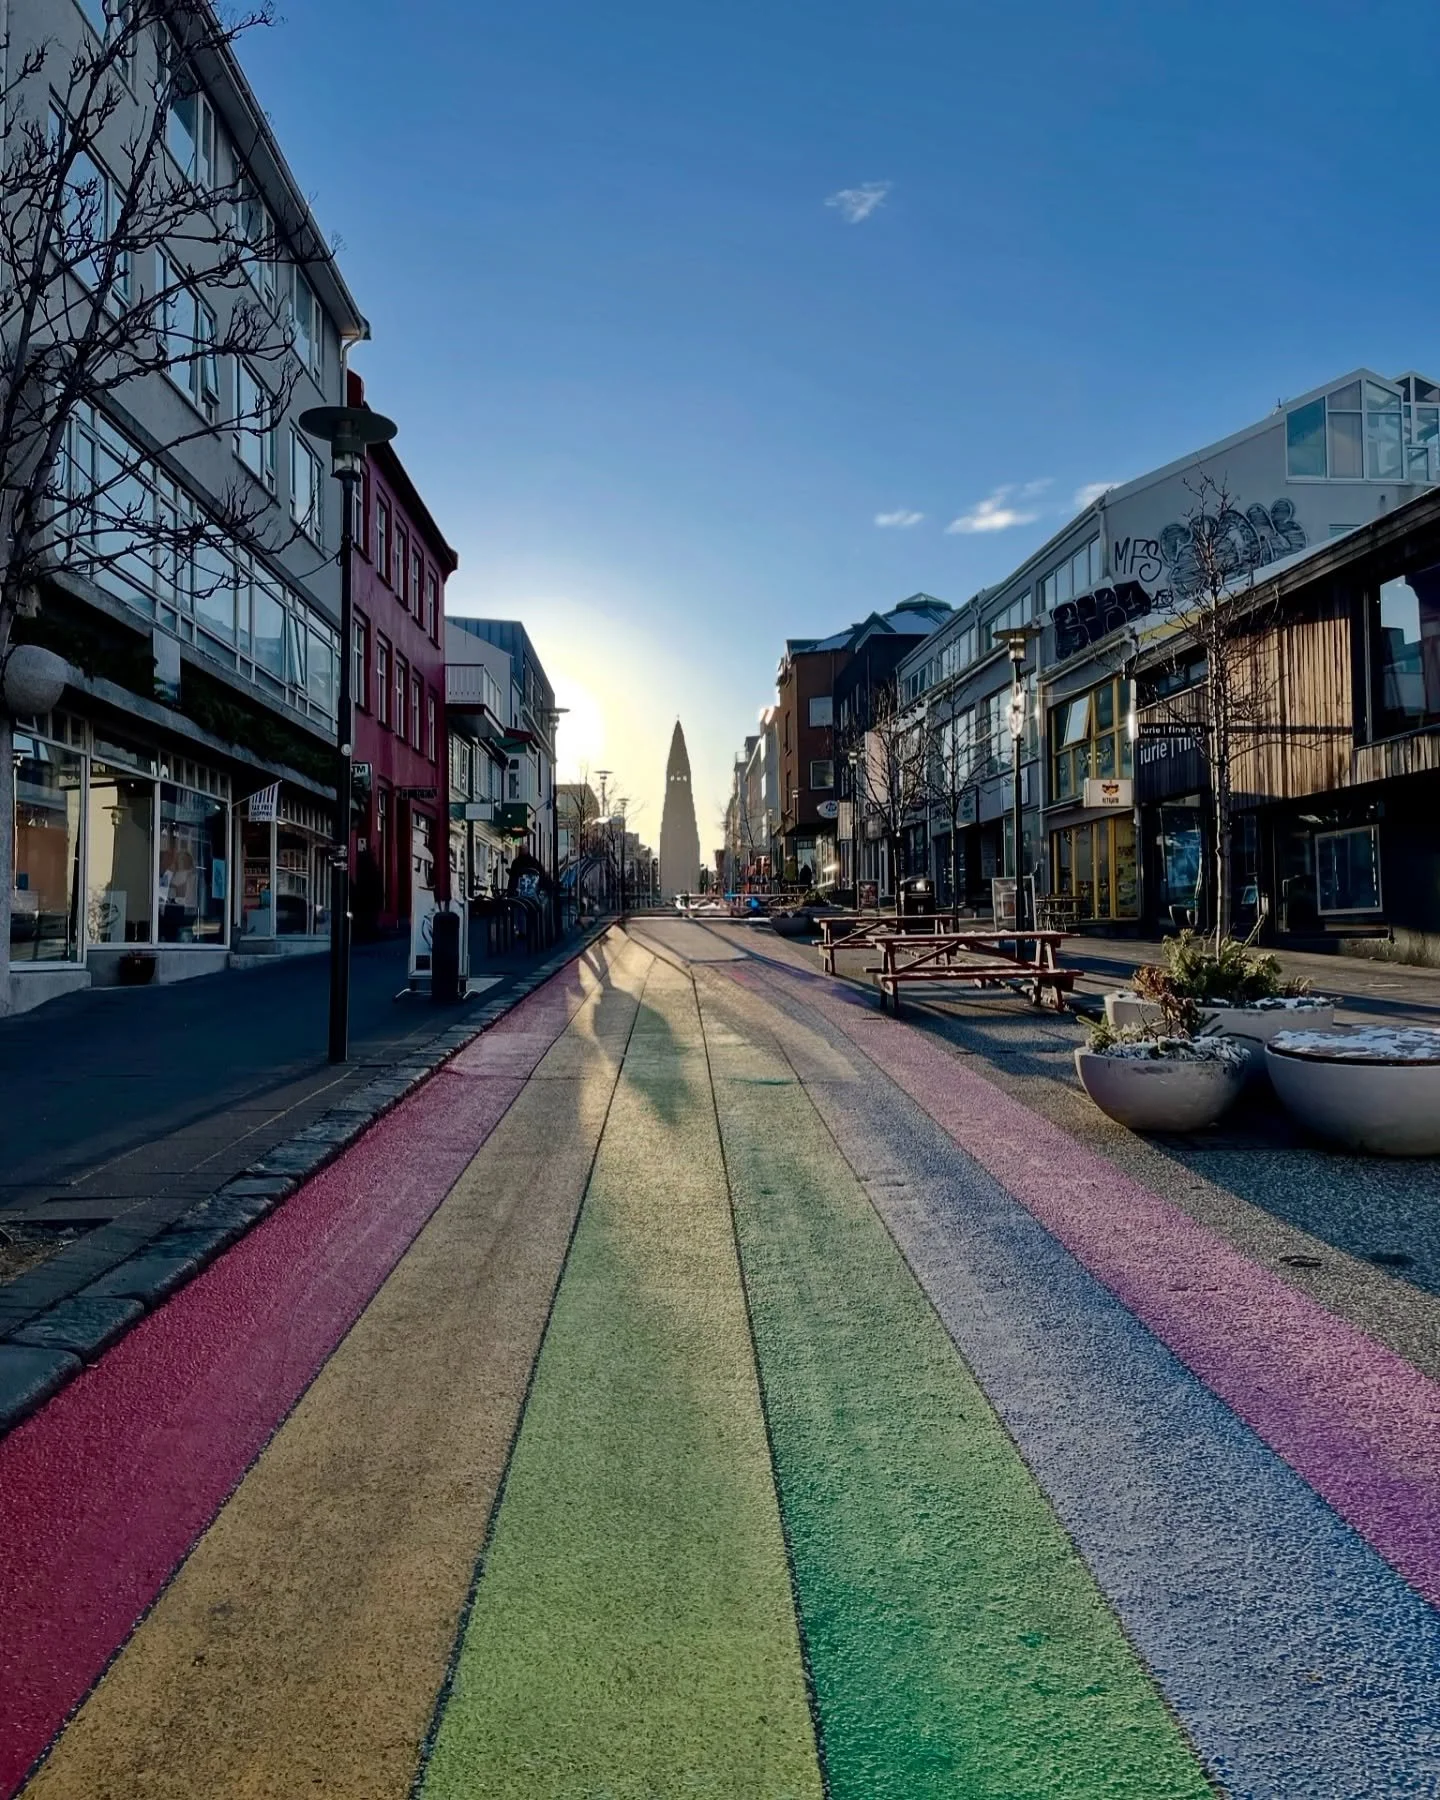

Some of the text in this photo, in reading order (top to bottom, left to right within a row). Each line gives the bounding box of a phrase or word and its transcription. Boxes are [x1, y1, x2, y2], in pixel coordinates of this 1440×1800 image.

[1115, 536, 1163, 583] MFS
[1140, 725, 1160, 734] iurie
[1168, 725, 1186, 733] fine
[1140, 738, 1168, 766] iurie
